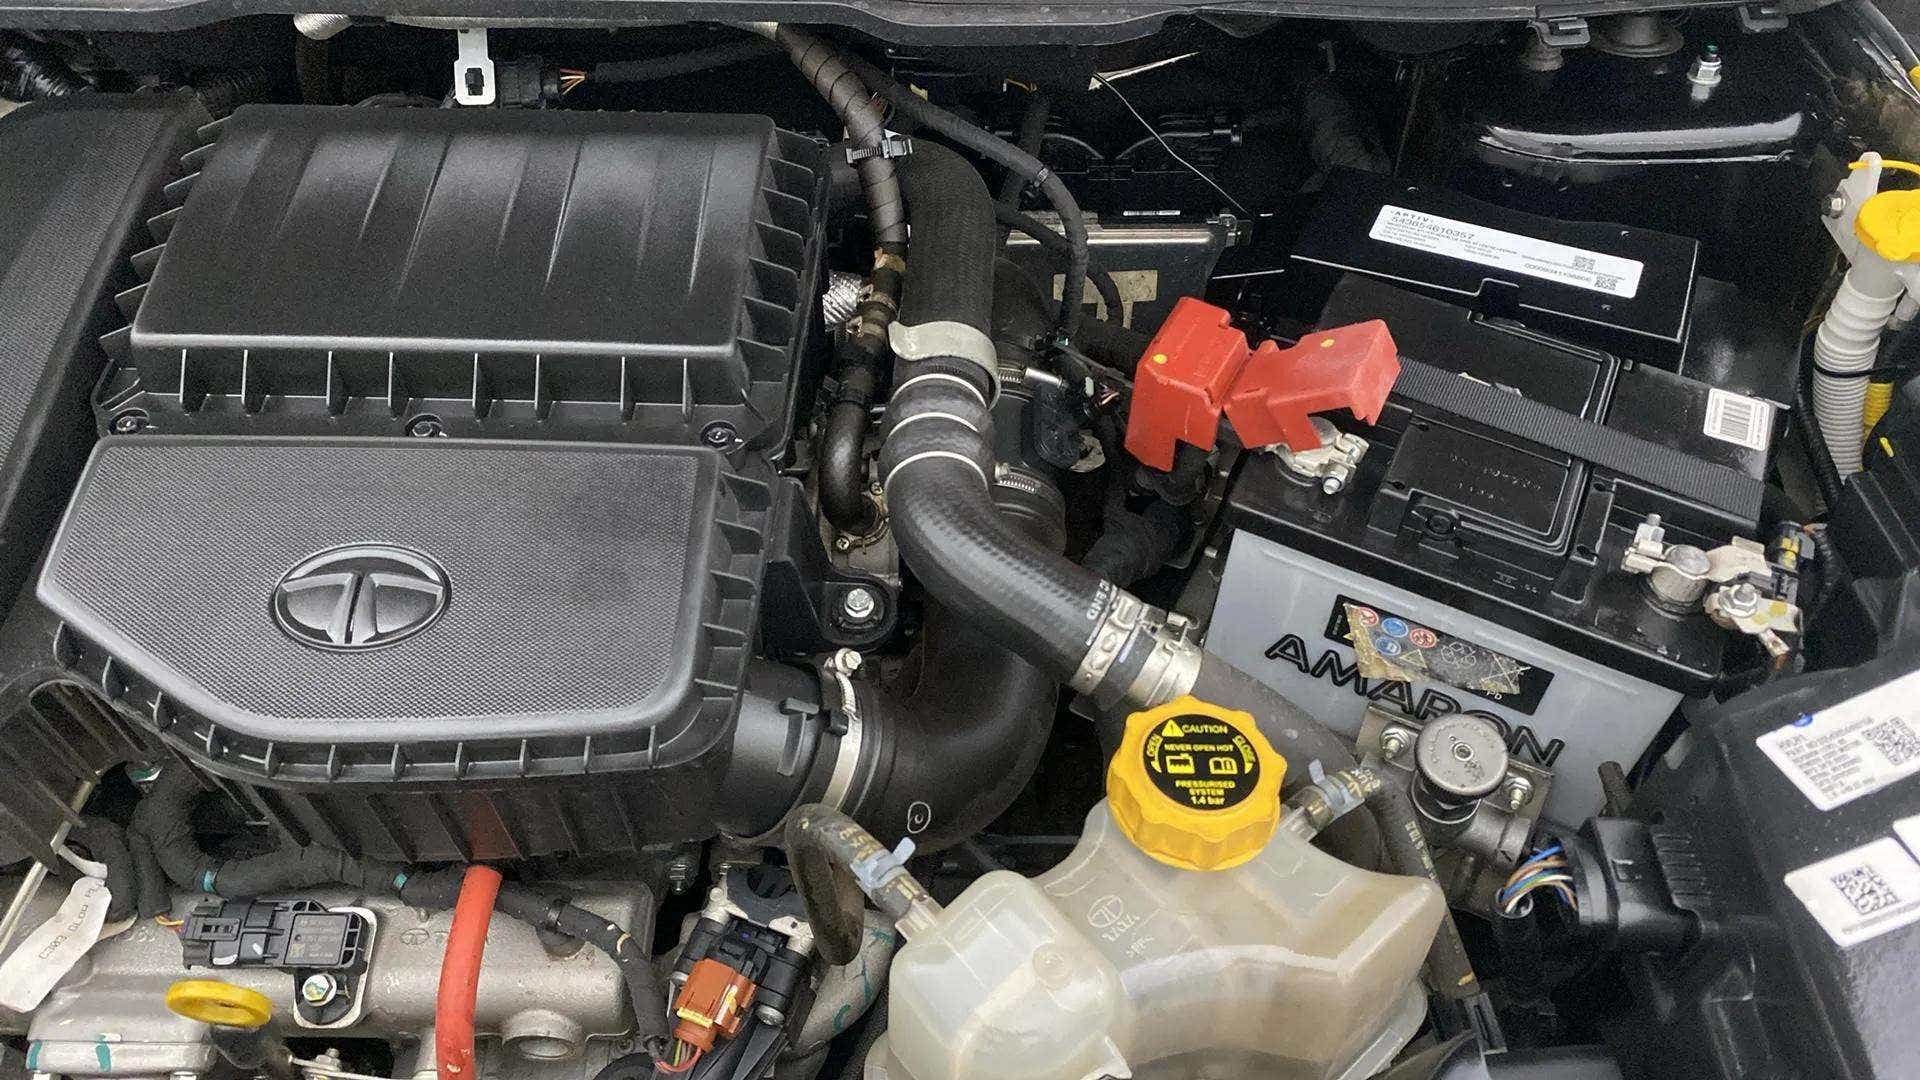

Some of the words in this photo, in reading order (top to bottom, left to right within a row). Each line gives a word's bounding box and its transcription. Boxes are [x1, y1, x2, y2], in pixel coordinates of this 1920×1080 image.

[1181, 724, 1229, 735] CAUTION
[1164, 743, 1192, 752] NEVER
[1193, 743, 1216, 752] OPEN
[1216, 744, 1234, 752] HOT
[1189, 788, 1225, 796] SYSTEM
[1191, 796, 1206, 805] 1.4
